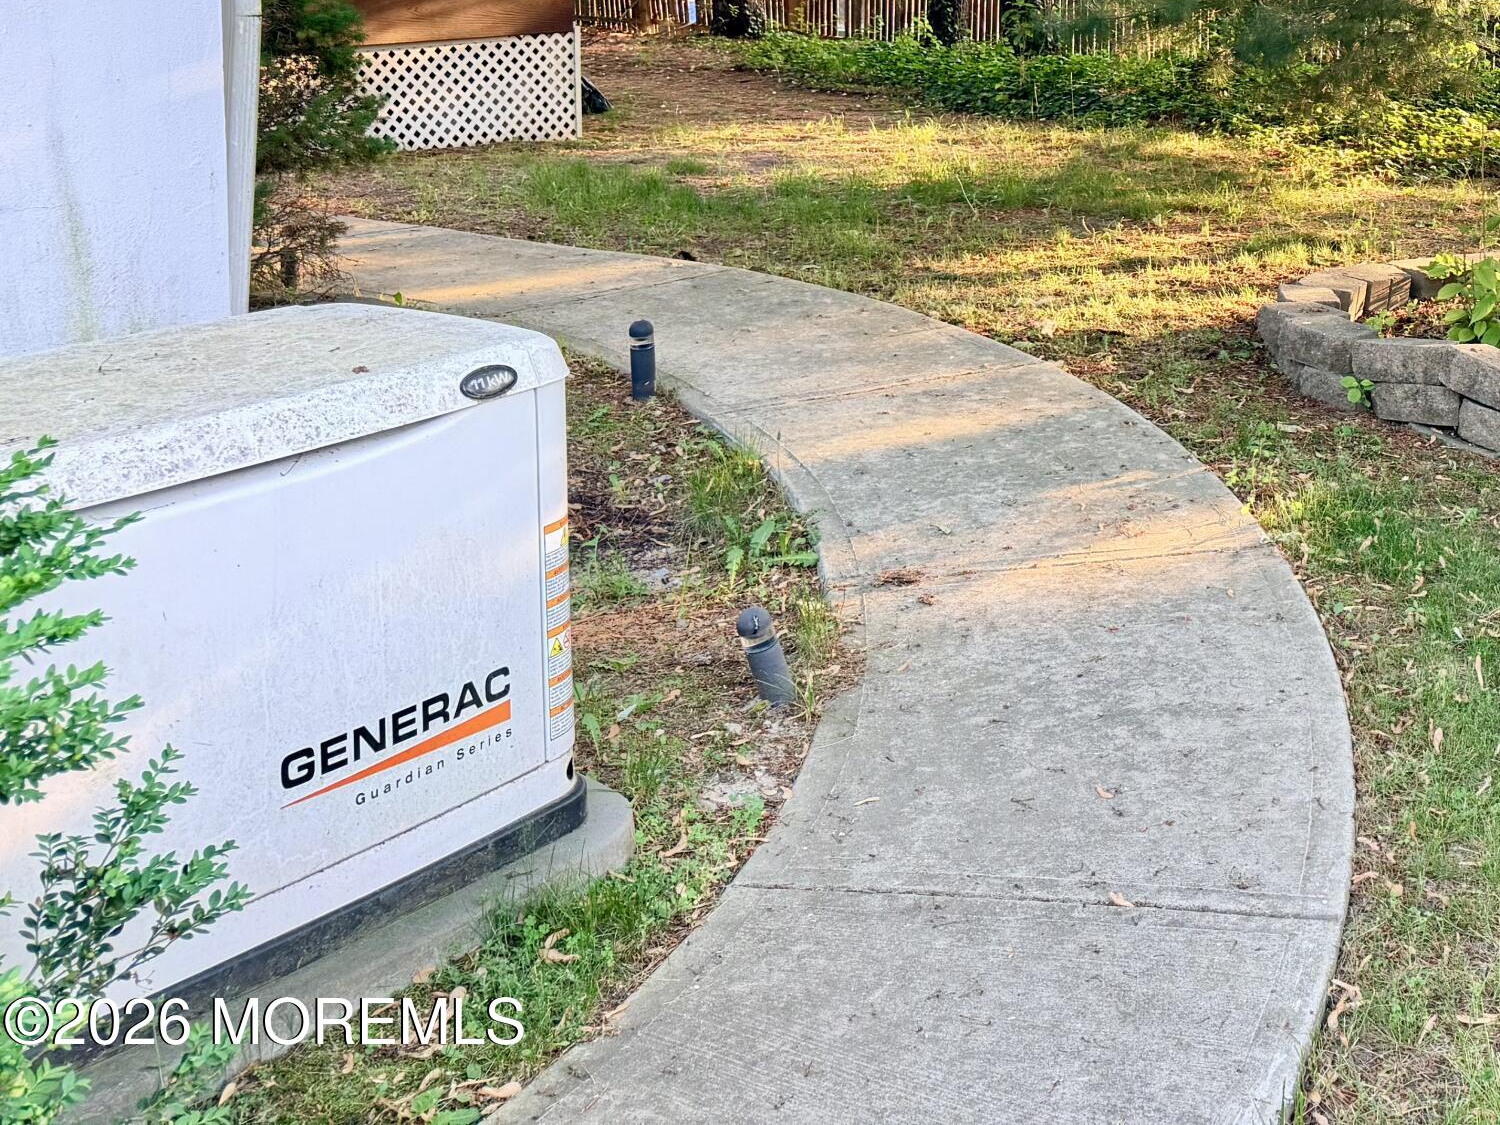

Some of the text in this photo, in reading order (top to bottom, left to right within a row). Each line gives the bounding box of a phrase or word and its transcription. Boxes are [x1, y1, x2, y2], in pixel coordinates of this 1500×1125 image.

[281, 666, 510, 789] GENERAC
[355, 728, 513, 805] Guardian Series
